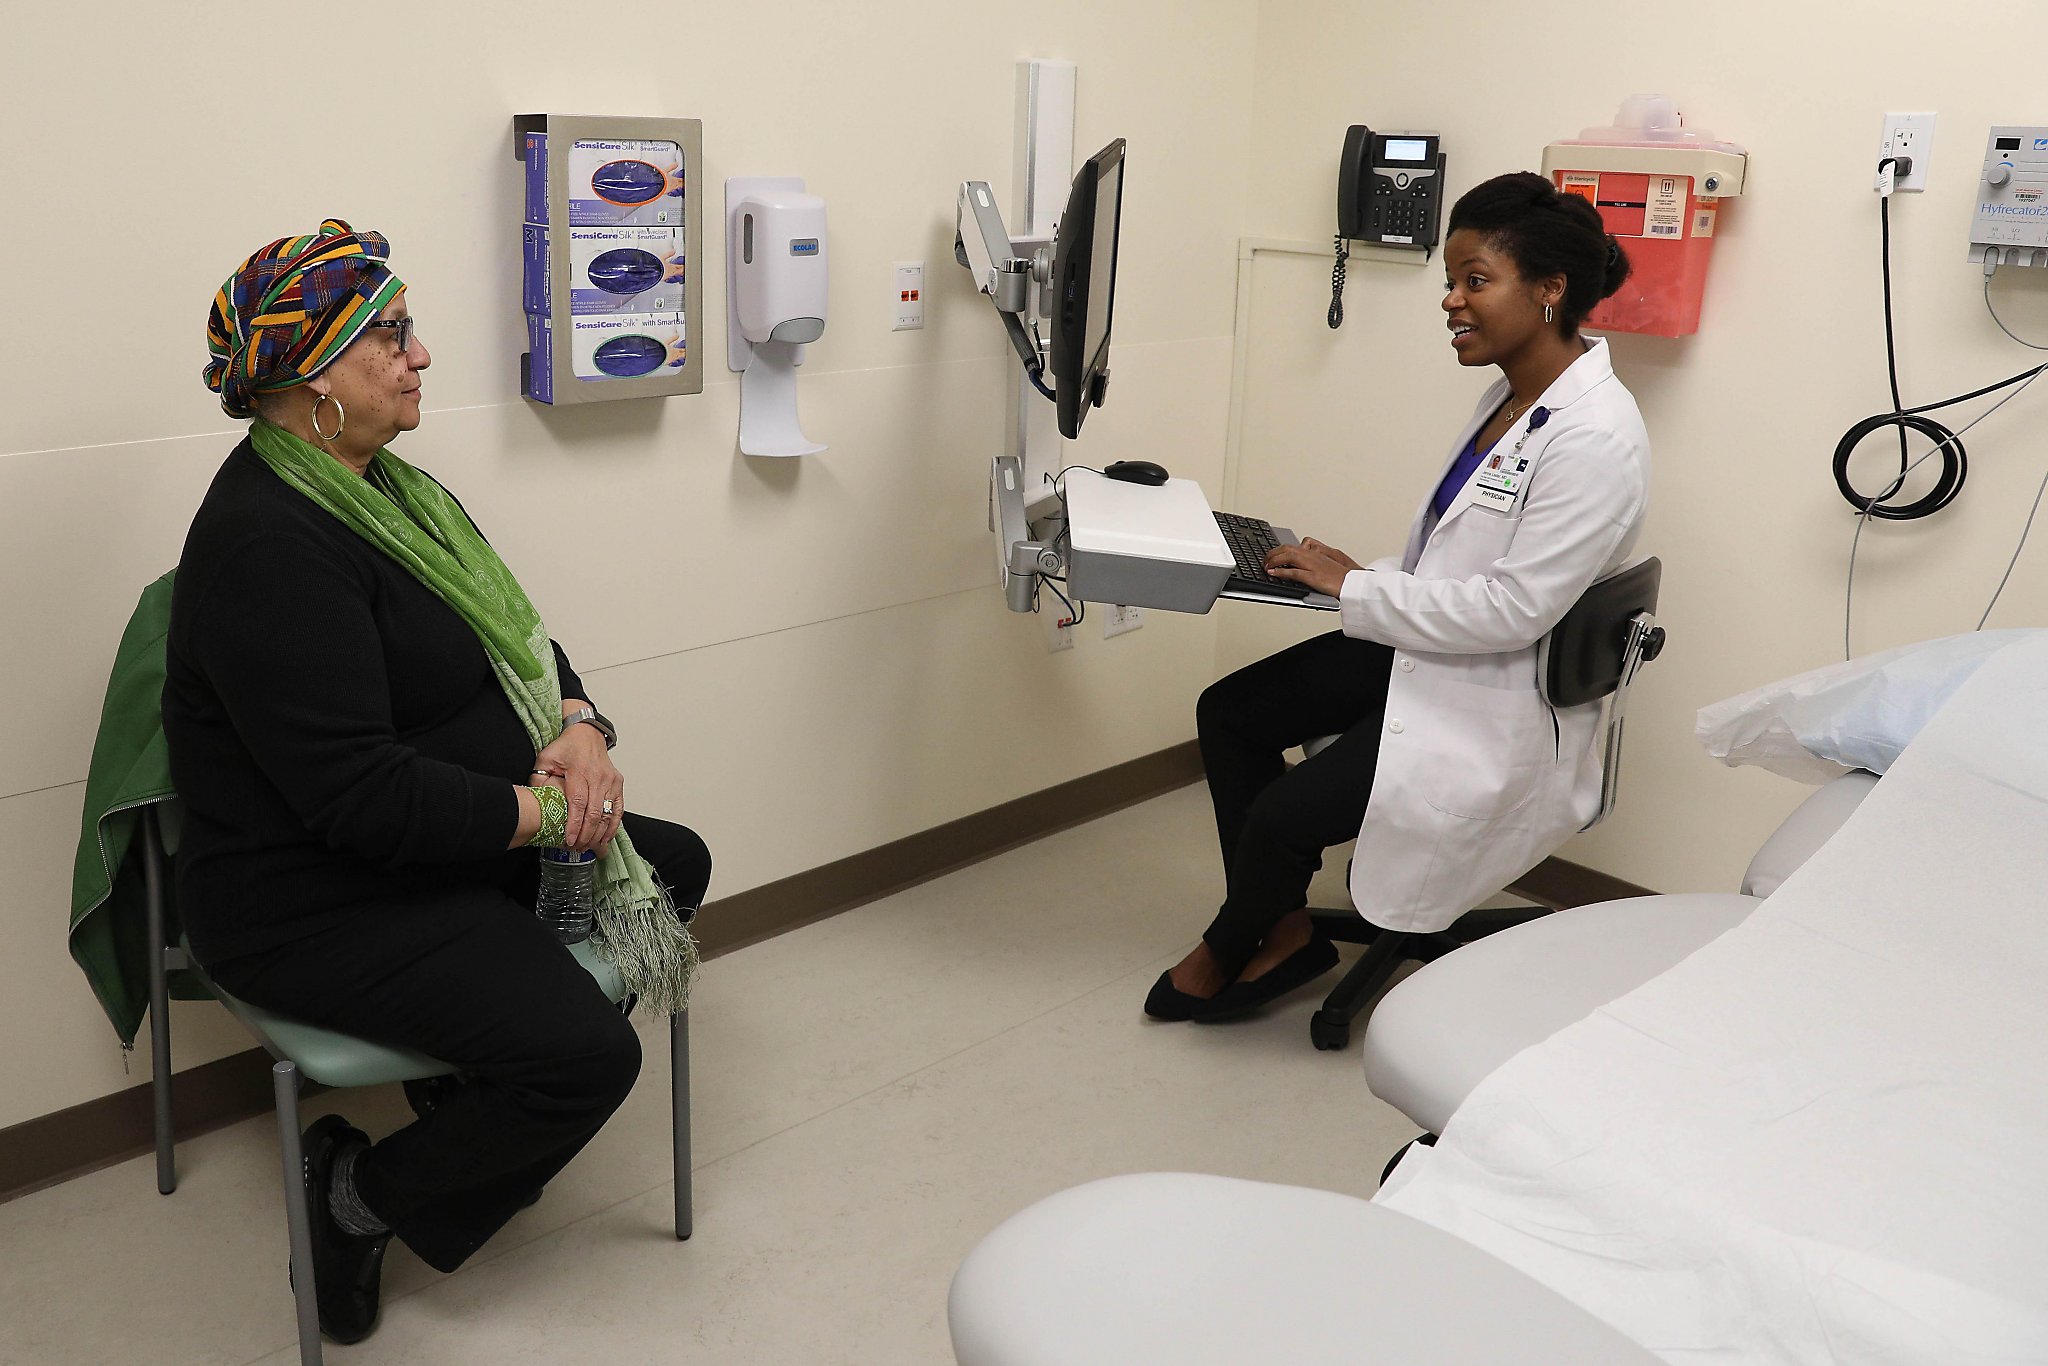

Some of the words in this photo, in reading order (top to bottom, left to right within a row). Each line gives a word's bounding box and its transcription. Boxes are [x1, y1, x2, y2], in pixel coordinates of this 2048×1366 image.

[574, 141, 621, 150] SensiCare
[526, 228, 534, 244] M
[571, 232, 618, 240] SensiCare
[575, 321, 622, 329] SensiCare
[642, 319, 656, 327] with
[1482, 490, 1506, 501] PHYSICIAN
